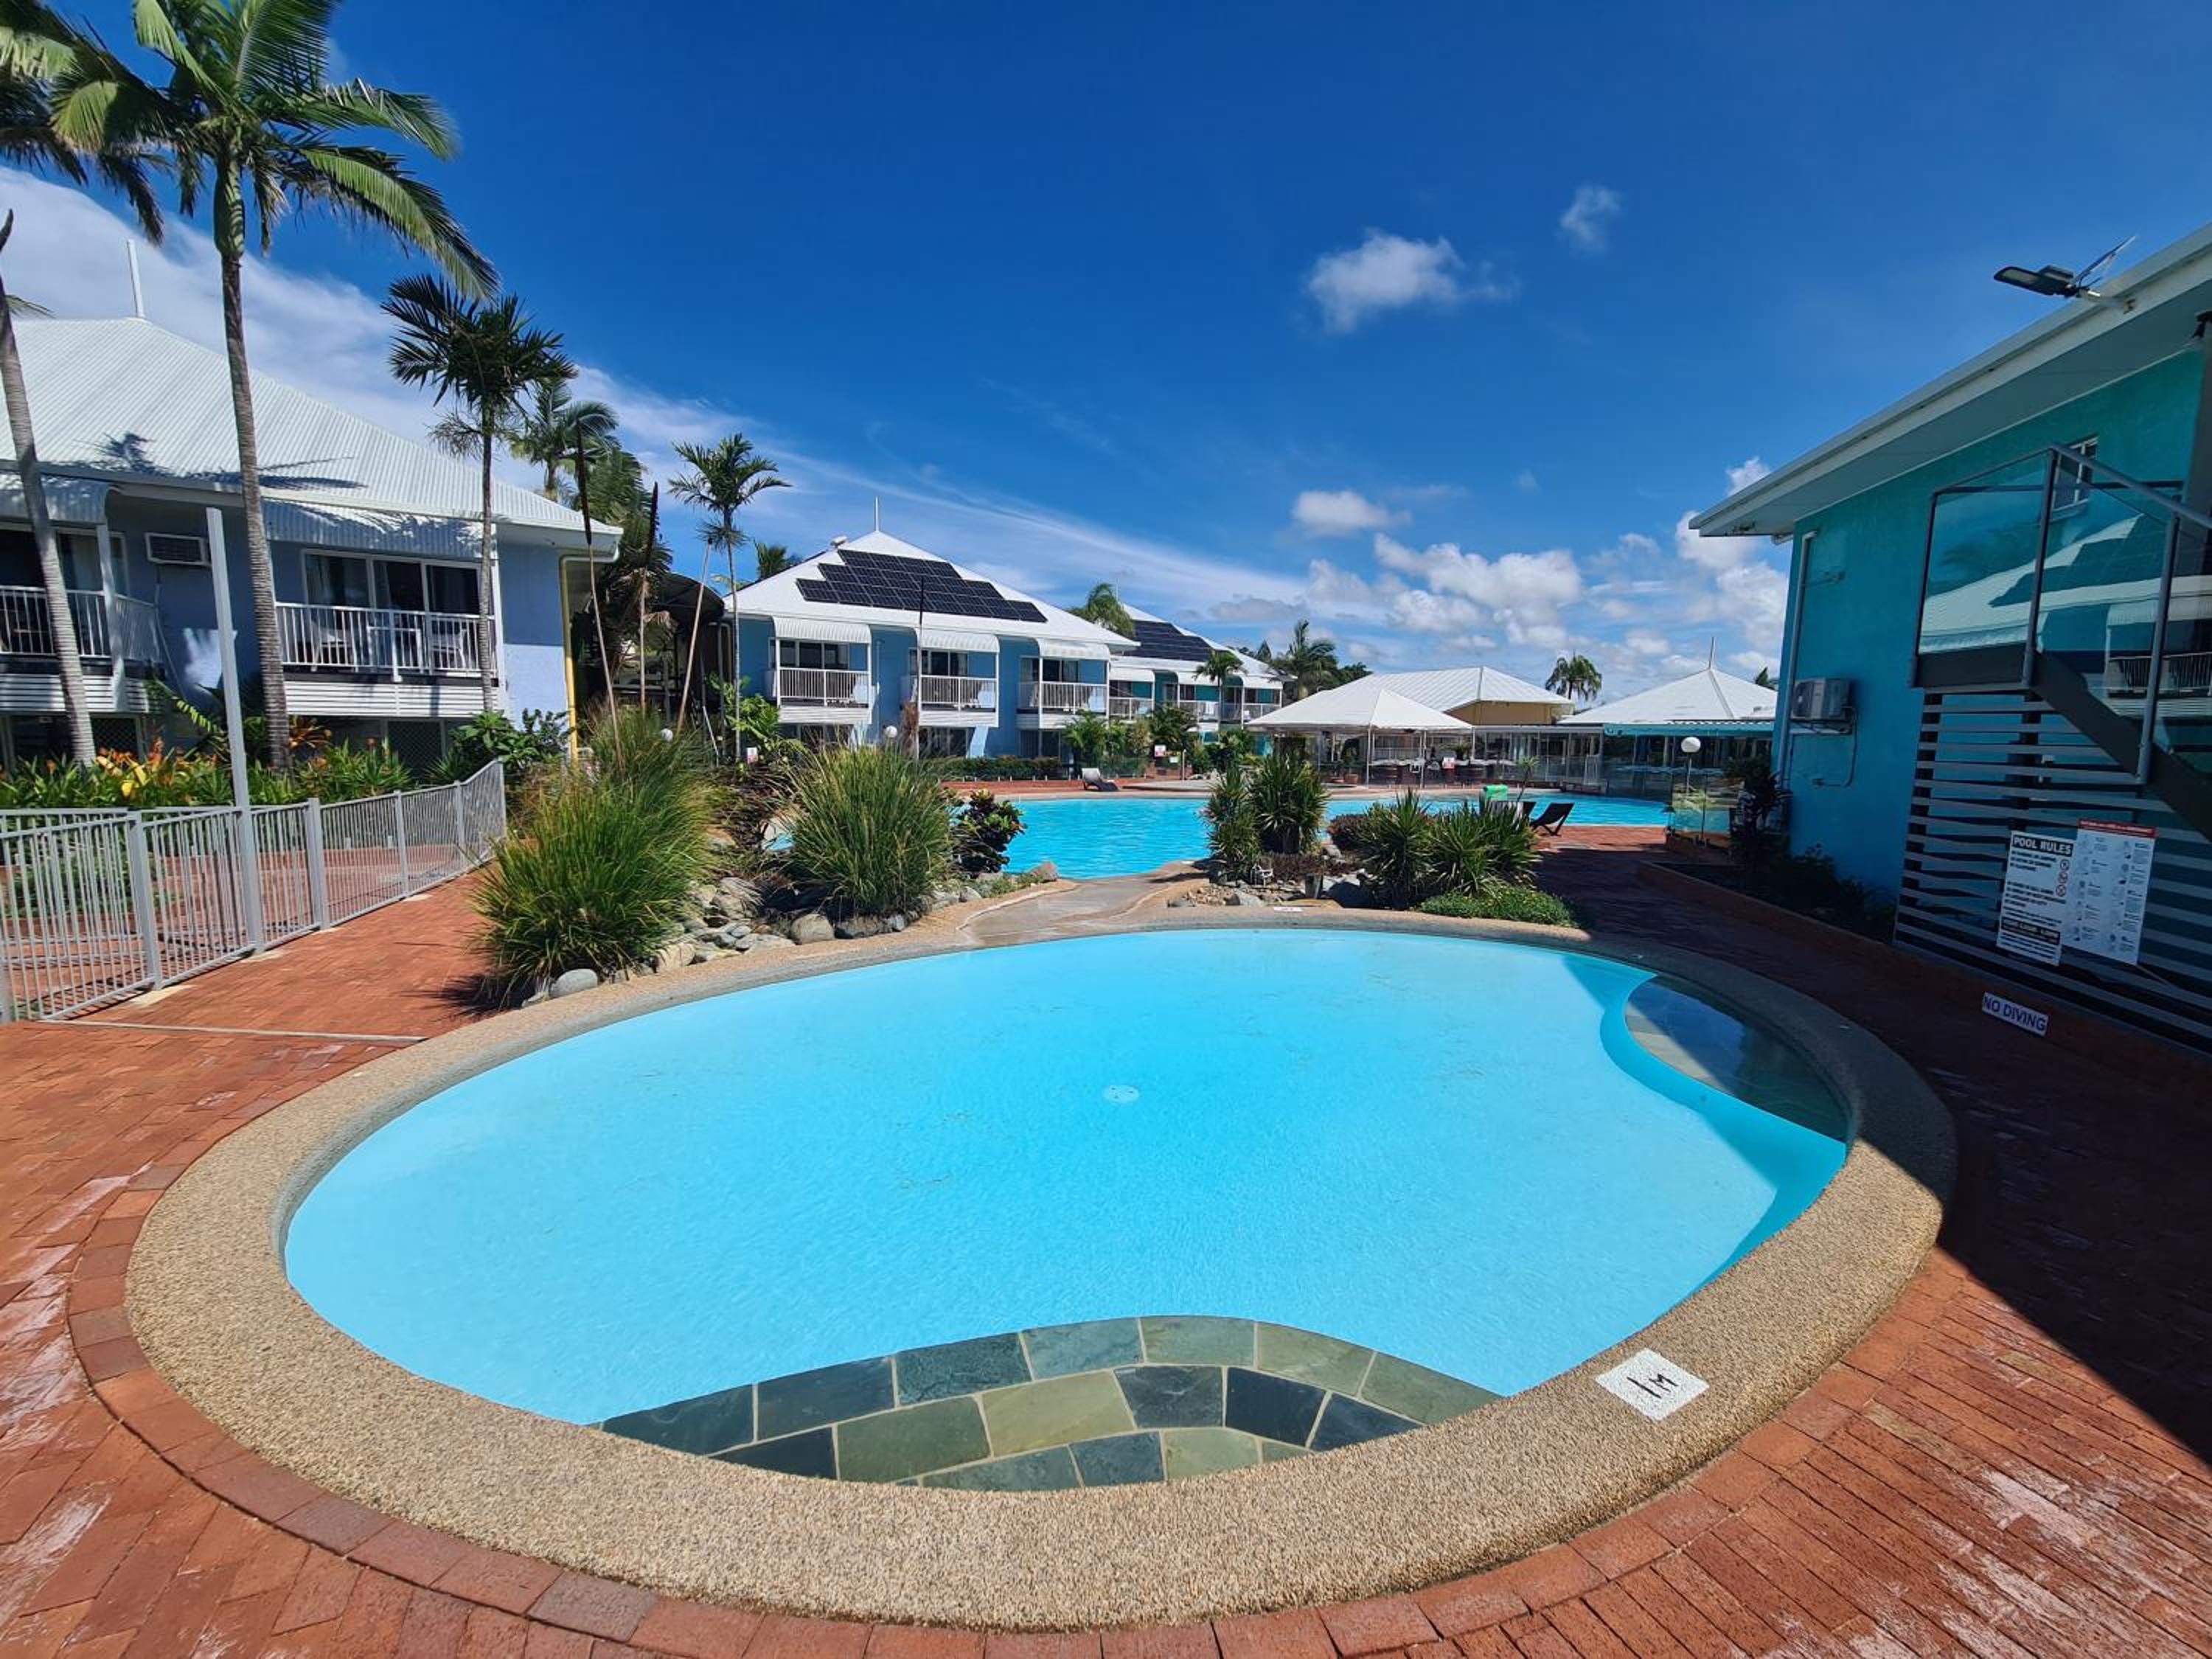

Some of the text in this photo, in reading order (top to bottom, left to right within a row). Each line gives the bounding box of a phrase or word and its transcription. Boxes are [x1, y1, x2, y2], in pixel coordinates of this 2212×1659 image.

[2014, 837, 2071, 855] POOL RULES
[1984, 996, 2046, 1031] NO DIVING
